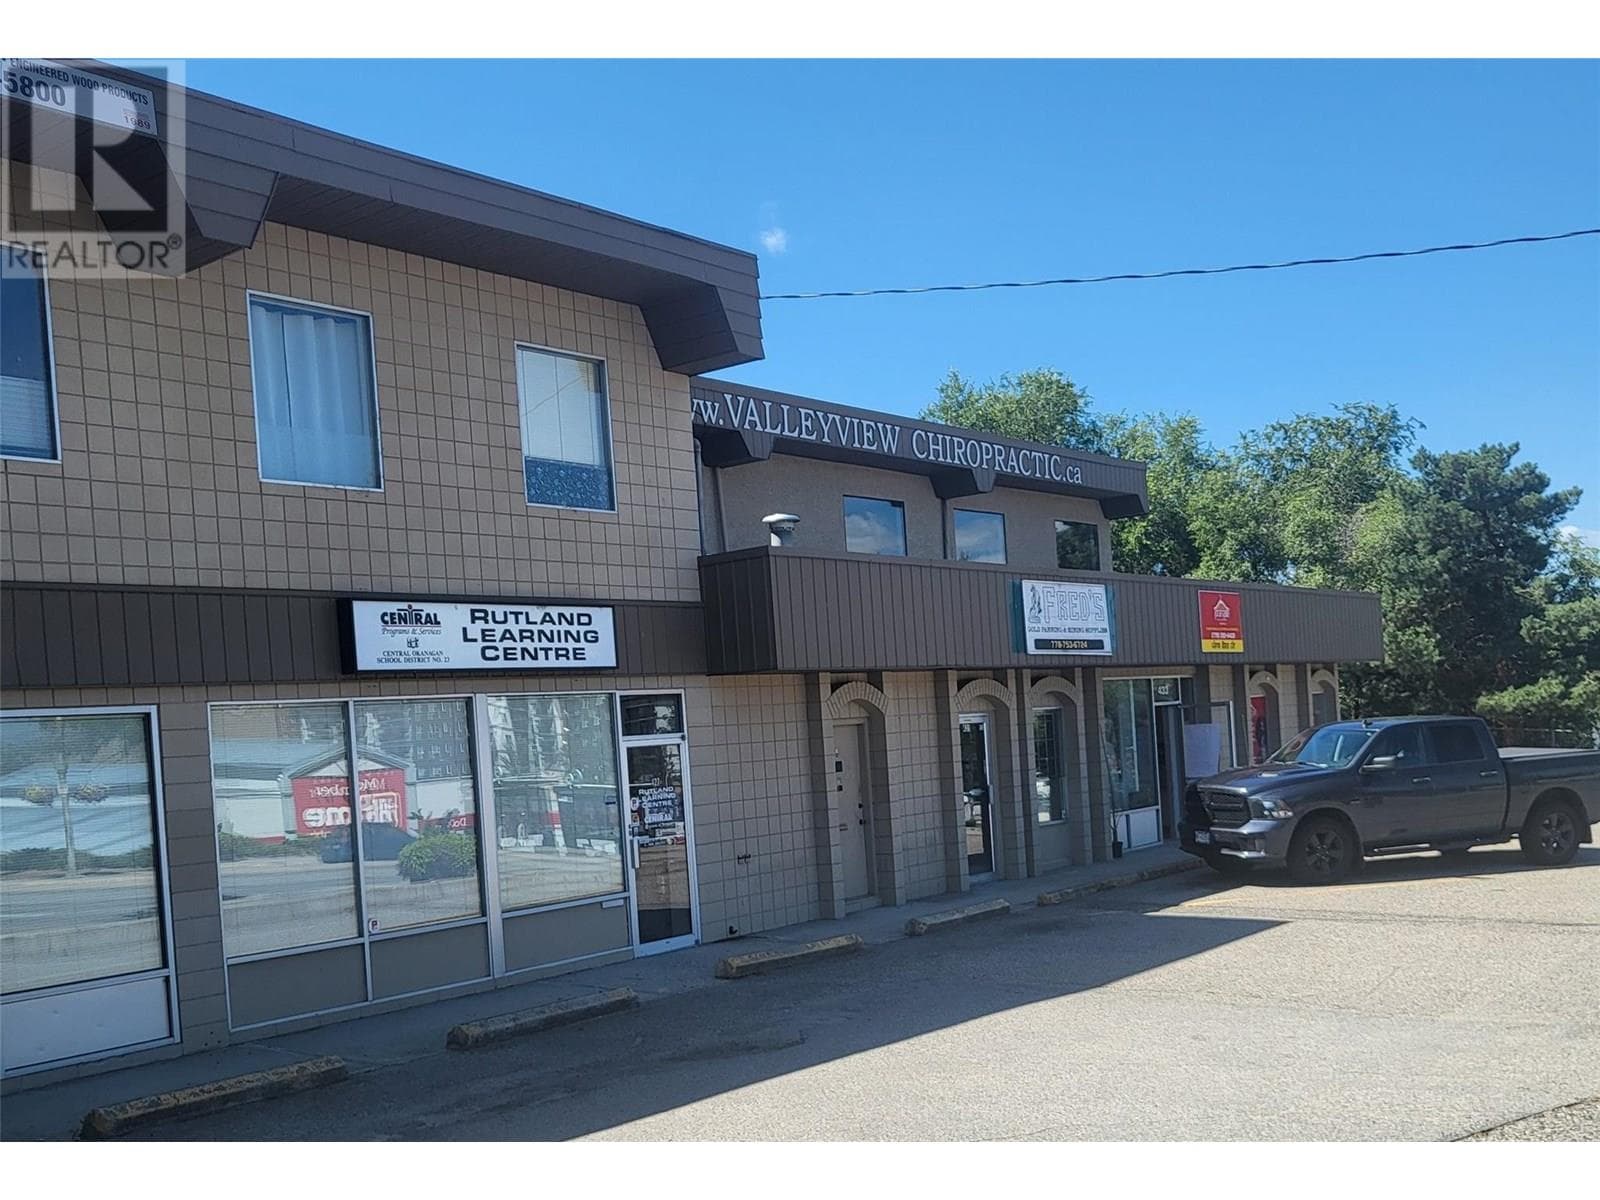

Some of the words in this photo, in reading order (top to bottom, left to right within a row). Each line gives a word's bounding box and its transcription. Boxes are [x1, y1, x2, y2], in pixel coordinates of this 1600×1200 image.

[10, 58, 69, 82] ENGINEERED
[71, 74, 99, 90] WOOD
[102, 83, 149, 105] PRODUCTS
[912, 429, 1082, 485] CHIROPRACTIC.ca
[380, 607, 441, 625] CENTRAL
[470, 608, 593, 626] RUTLAND
[462, 626, 599, 643] LEARNING
[480, 645, 587, 661] CENTRE
